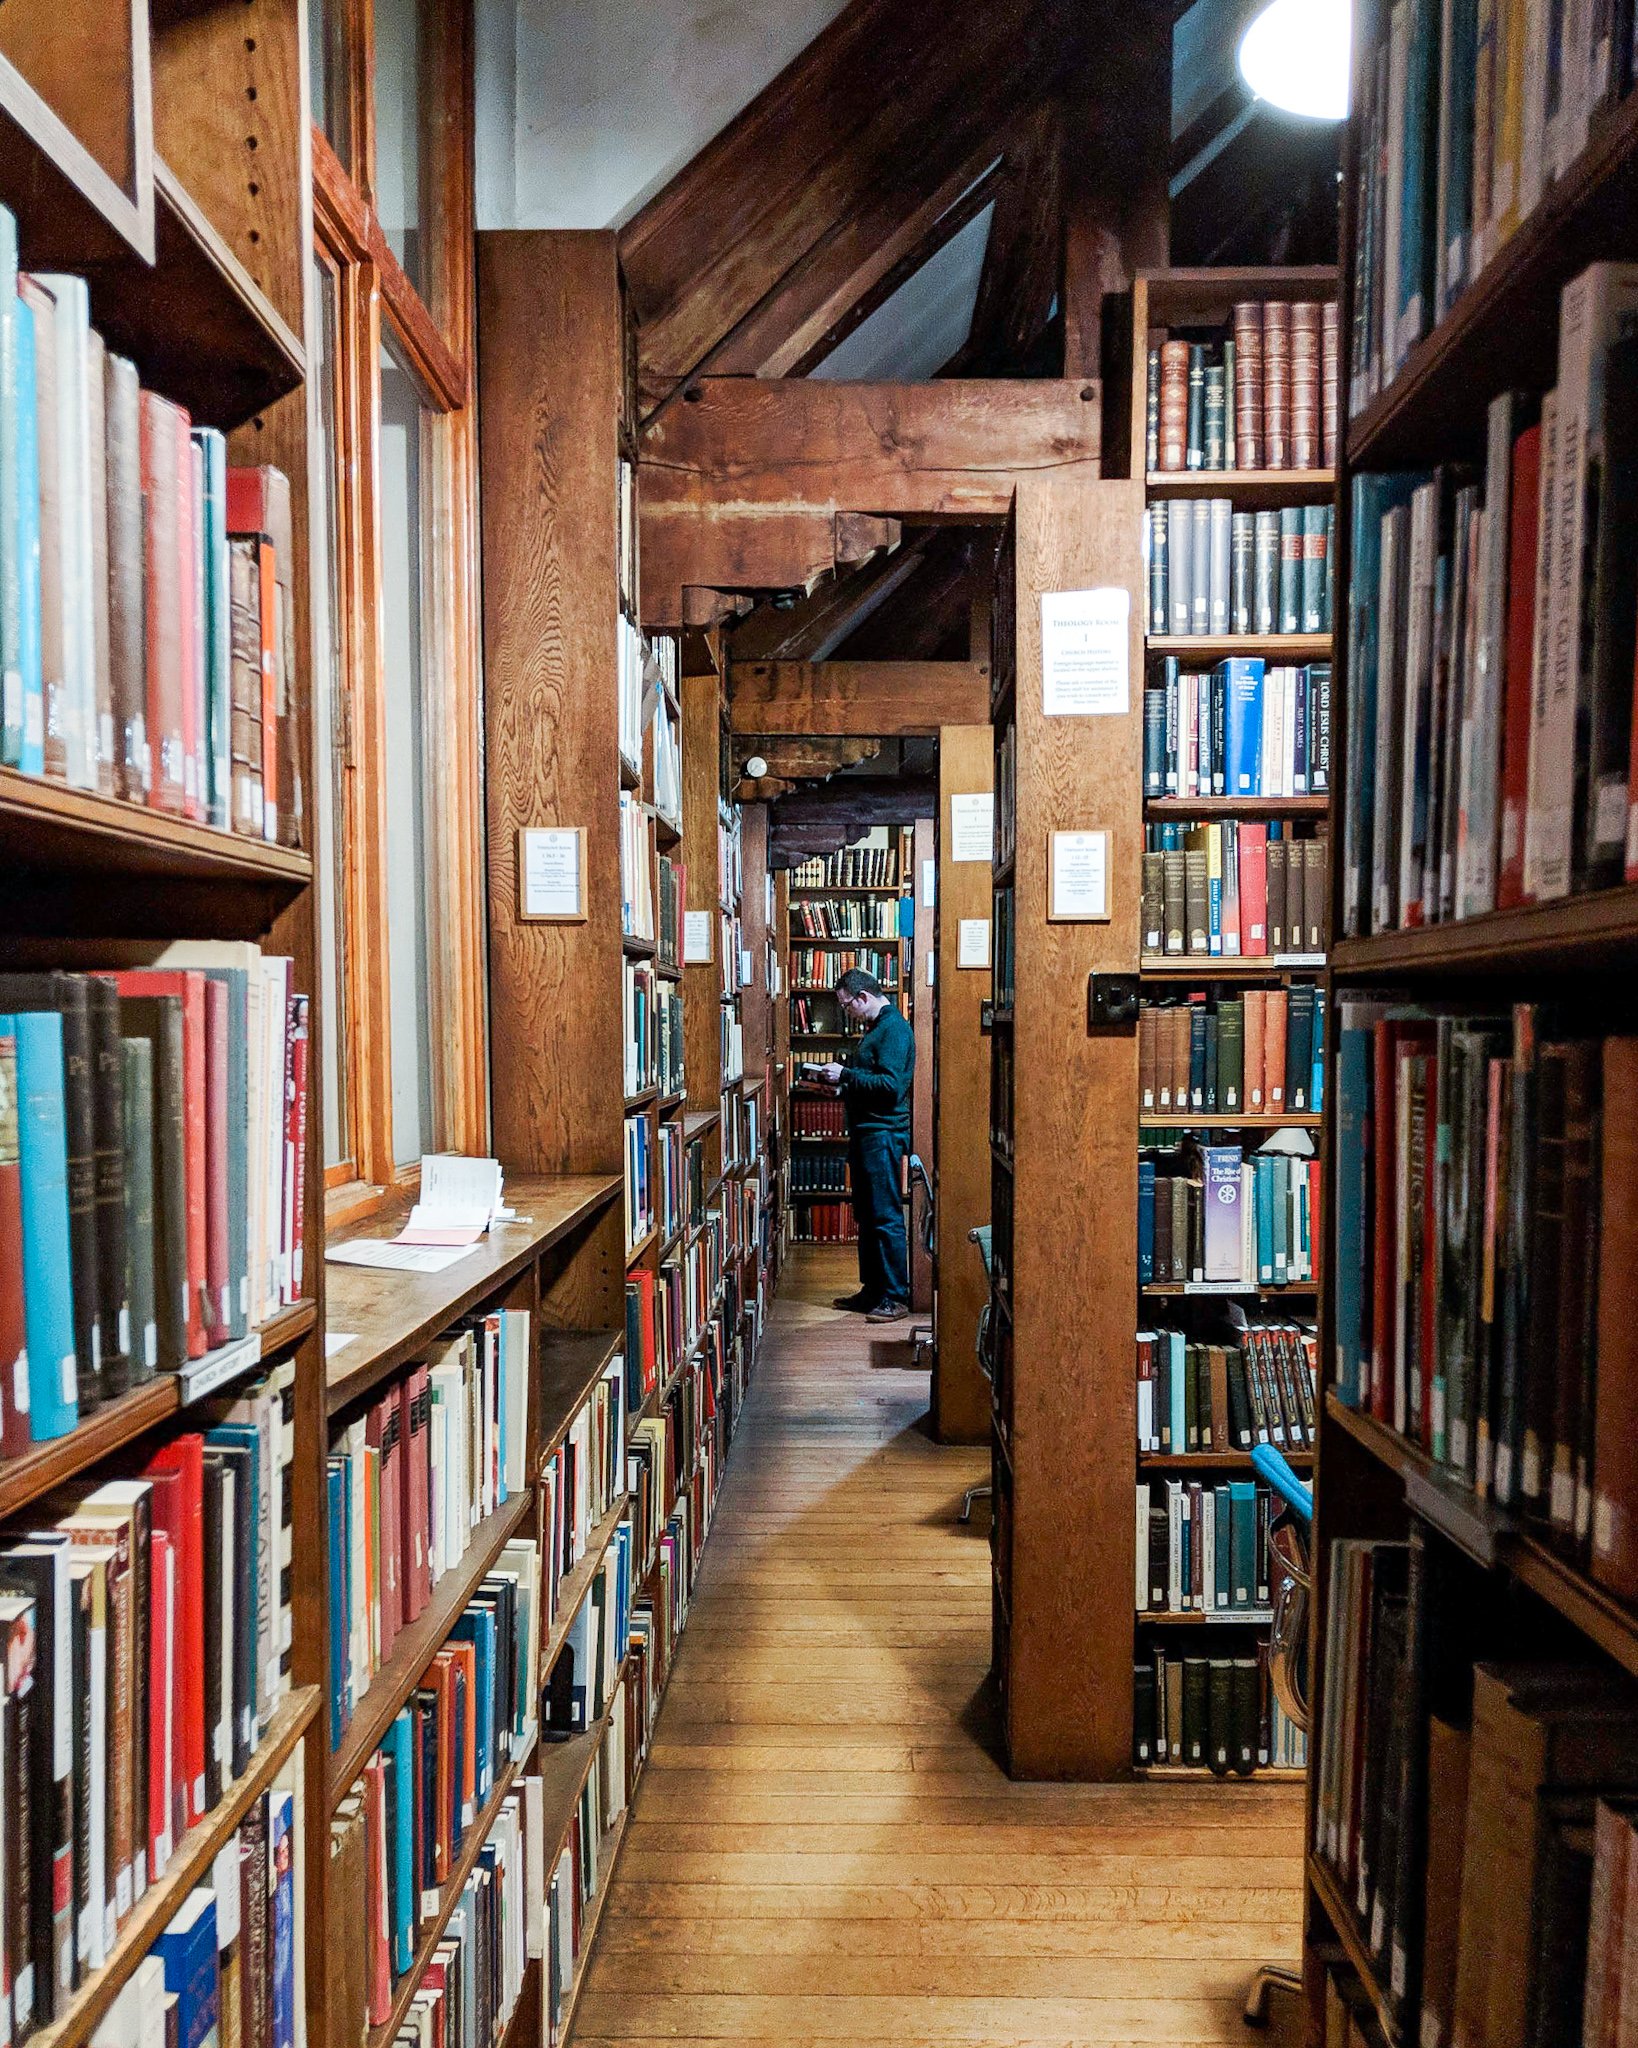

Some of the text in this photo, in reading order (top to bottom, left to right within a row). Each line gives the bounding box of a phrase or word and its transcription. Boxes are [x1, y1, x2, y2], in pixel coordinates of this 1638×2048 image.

[1319, 681, 1330, 771] LORD JESUS CHRIST
[298, 1091, 307, 1134] POPE
[297, 1142, 306, 1228] BENEDICT
